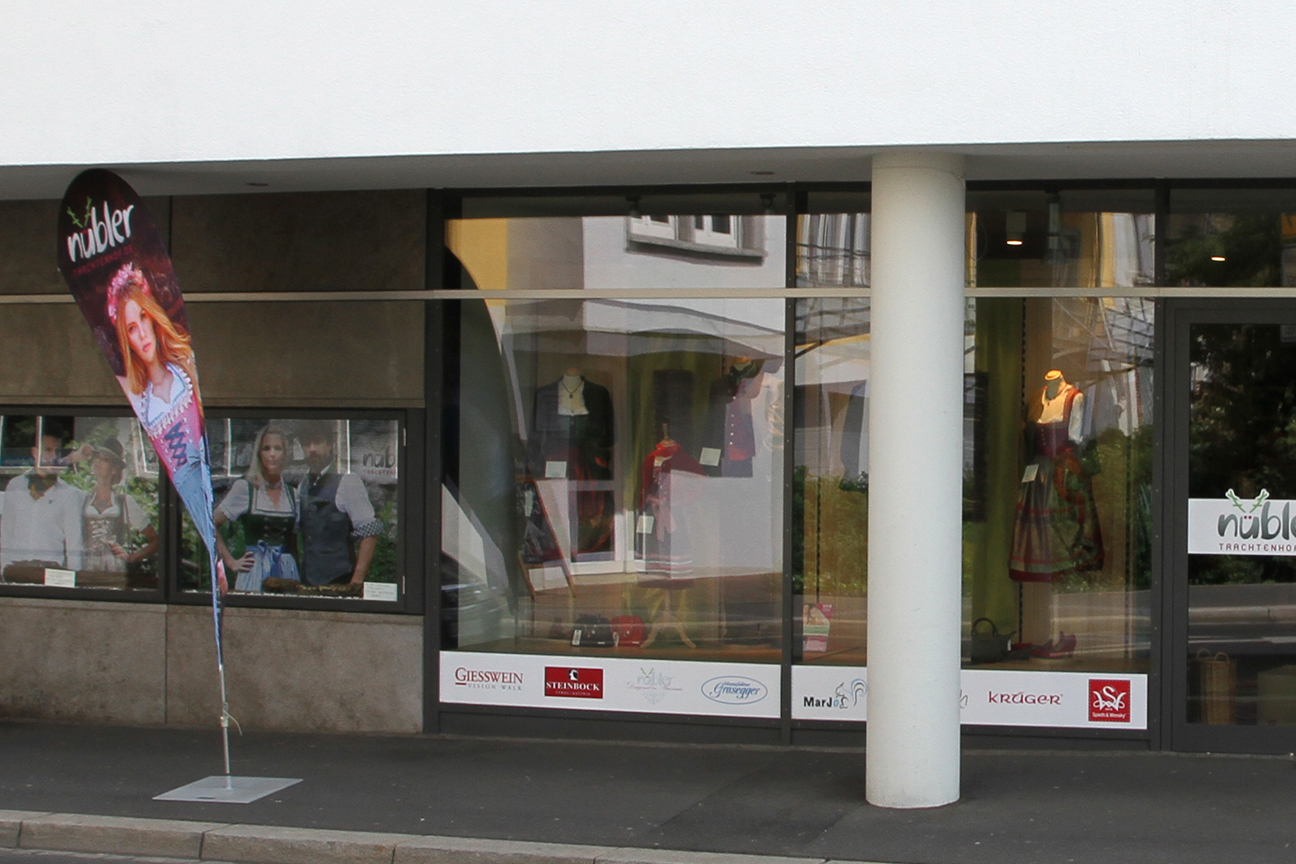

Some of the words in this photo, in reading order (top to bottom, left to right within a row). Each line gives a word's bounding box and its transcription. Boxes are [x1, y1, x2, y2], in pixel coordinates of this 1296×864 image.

[455, 667, 523, 684] GIESSWEIN
[546, 681, 600, 691] STEINBOCK
[709, 682, 760, 699] Grasegger
